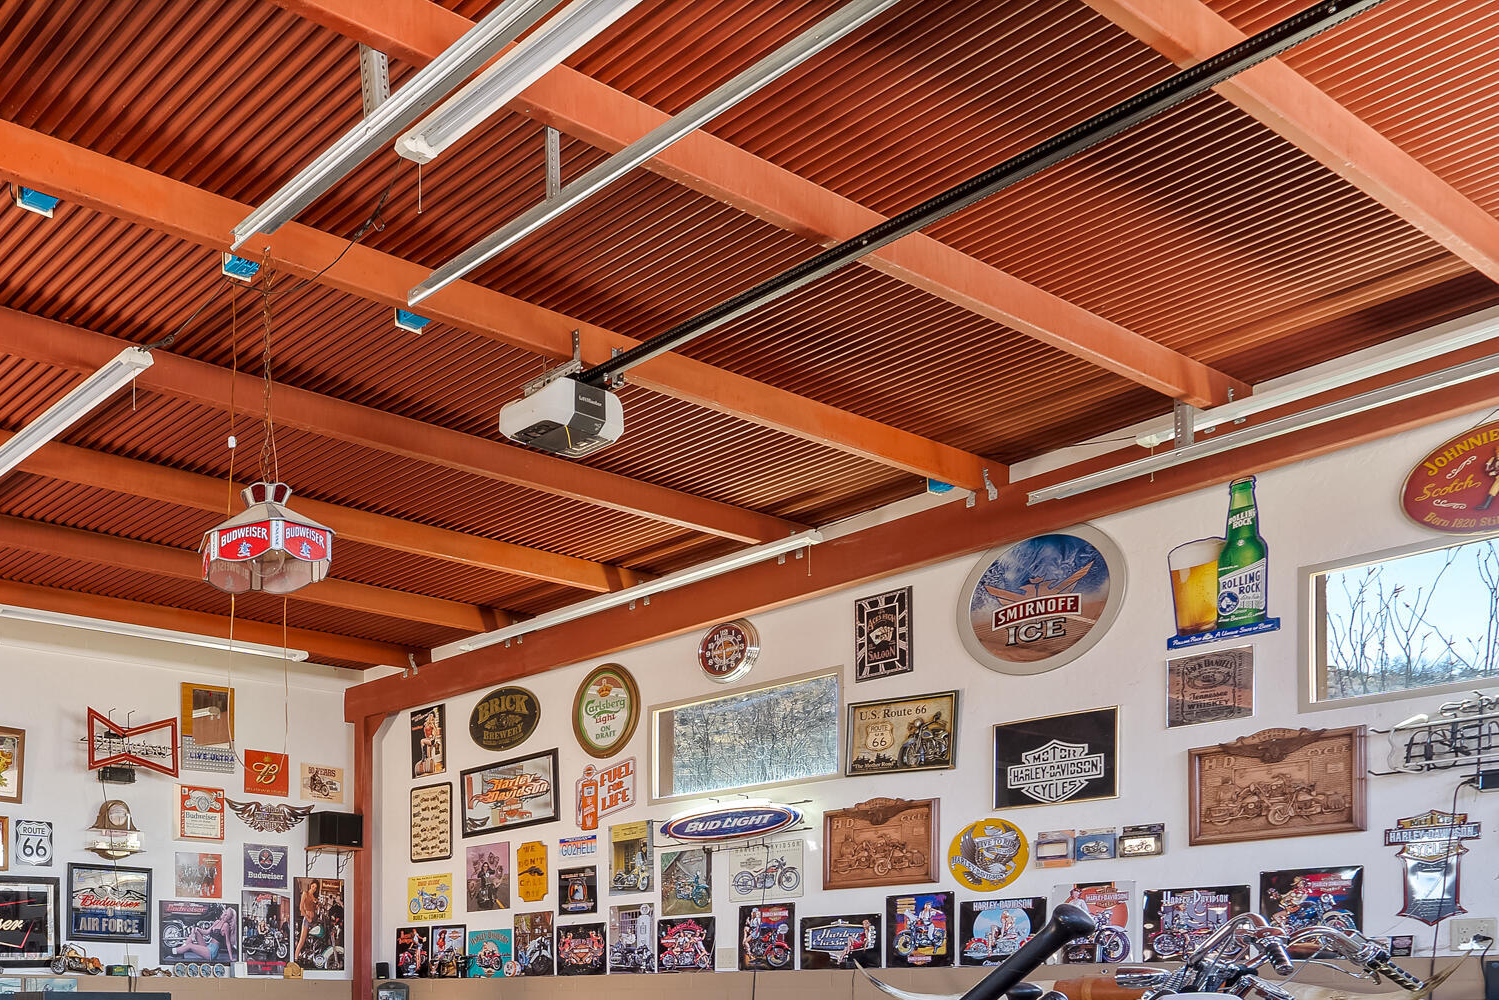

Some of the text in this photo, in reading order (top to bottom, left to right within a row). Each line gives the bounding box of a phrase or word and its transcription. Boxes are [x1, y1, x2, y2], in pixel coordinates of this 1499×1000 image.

[1423, 428, 1499, 477] JOHNNIE
[1414, 474, 1482, 502] Scotch
[1227, 508, 1256, 527] ROLLING
[1232, 517, 1253, 530] ROCK
[1423, 512, 1477, 528] Born 1820
[220, 526, 269, 548] BUDWEISER
[285, 526, 325, 549] BUDWEISER
[1221, 570, 1261, 590] ROLLING
[1238, 581, 1261, 595] ROCK
[997, 597, 1077, 625] SMIRNOFF
[1005, 617, 1067, 646] ICE
[868, 646, 896, 660] SALOON
[1184, 662, 1203, 676] JACK
[1190, 690, 1228, 701] Tennessee
[477, 694, 530, 725] BRICK
[584, 698, 626, 717] Carlsberg
[859, 704, 927, 721] U.S. Route 66
[1187, 699, 1231, 710] WHISKEY
[595, 713, 617, 725] Light
[483, 722, 524, 740] BREWERY
[595, 730, 617, 740] DRAFT
[600, 725, 611, 733] ON
[871, 737, 887, 748] 66
[189, 751, 235, 762] LIVE ULTRA
[1032, 746, 1078, 763] MOTOR
[1203, 755, 1236, 771] H D
[599, 762, 634, 787] FUEL
[1012, 759, 1099, 783] HARLEY-DAVIDSON
[492, 774, 536, 791] Harley
[607, 780, 624, 795] FOR
[1032, 780, 1078, 800] CYCLES
[487, 783, 549, 802] Davidson
[601, 787, 630, 811] LIFE
[185, 812, 218, 821] Budweiser
[684, 812, 775, 834] BUD LIGHT
[22, 826, 46, 836] ROUTE
[22, 837, 48, 858] 66
[561, 841, 596, 857] GO2HELL
[247, 871, 285, 881] Budweiser
[78, 892, 141, 909] Budweiser
[972, 899, 1034, 912] HARLEY-DAVIDSON
[79, 916, 140, 934] AIR FORCE
